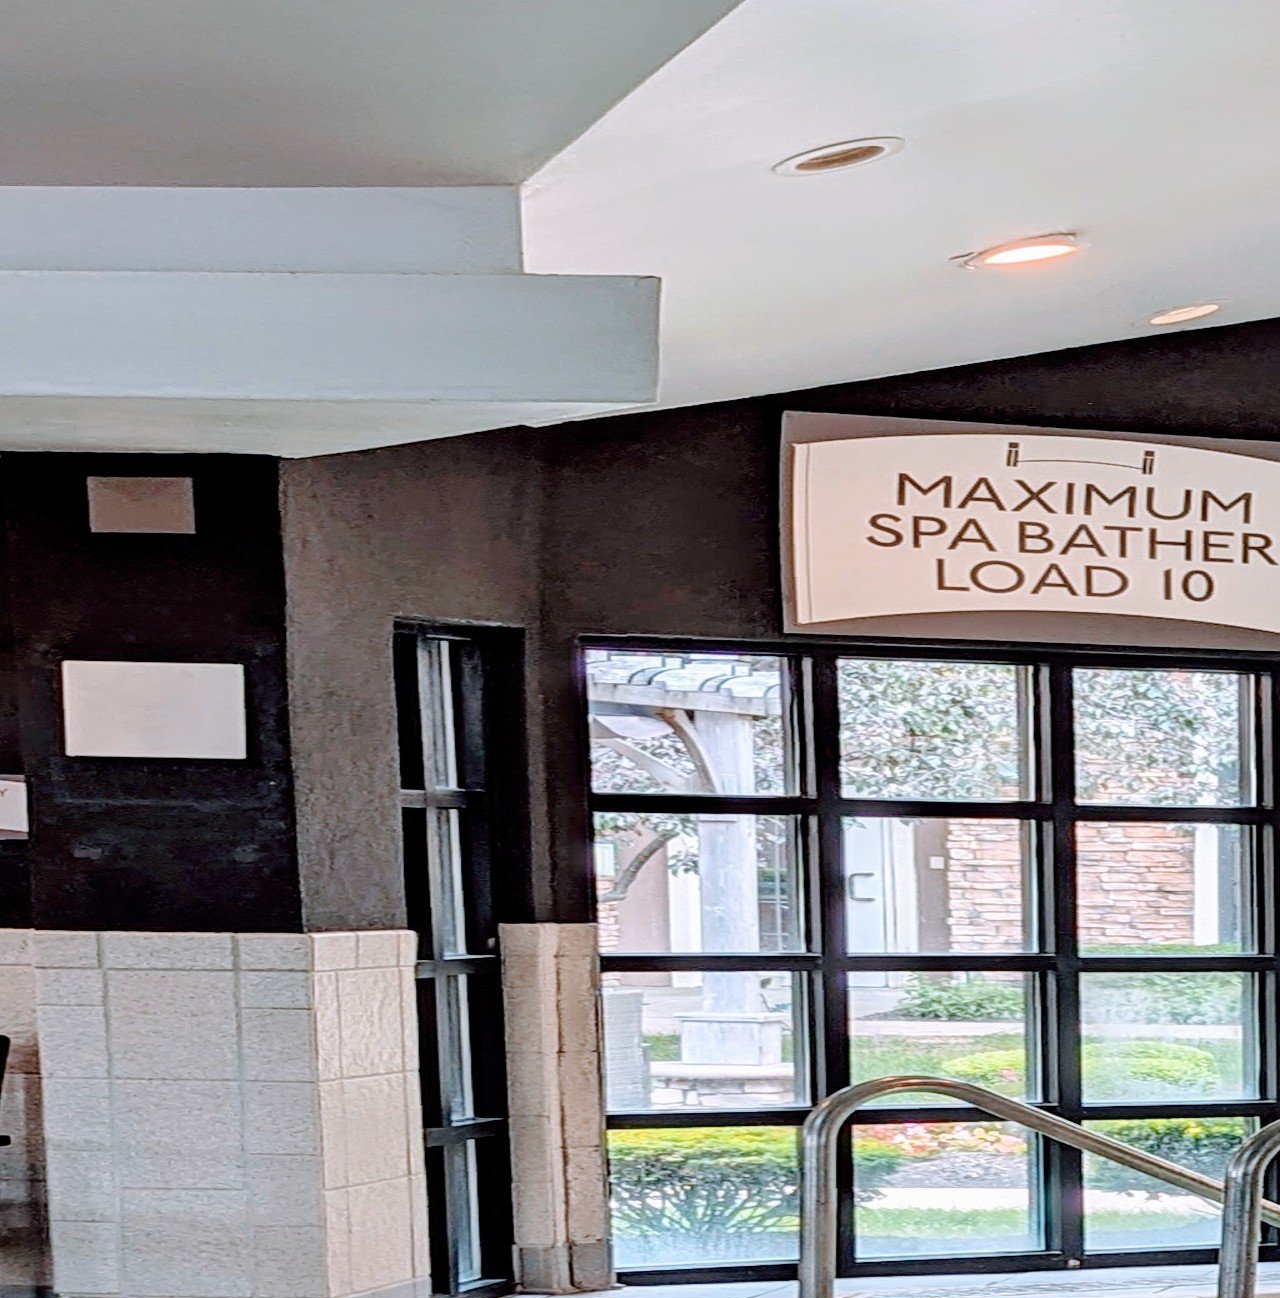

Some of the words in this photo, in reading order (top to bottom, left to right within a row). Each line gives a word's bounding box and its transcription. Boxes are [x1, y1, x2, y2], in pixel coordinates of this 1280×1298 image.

[896, 473, 1253, 525] MAXIMUM
[866, 513, 997, 552] SPA
[1017, 521, 1280, 565] BATHER
[936, 558, 1129, 598] LOAD
[1163, 568, 1215, 602] 10
